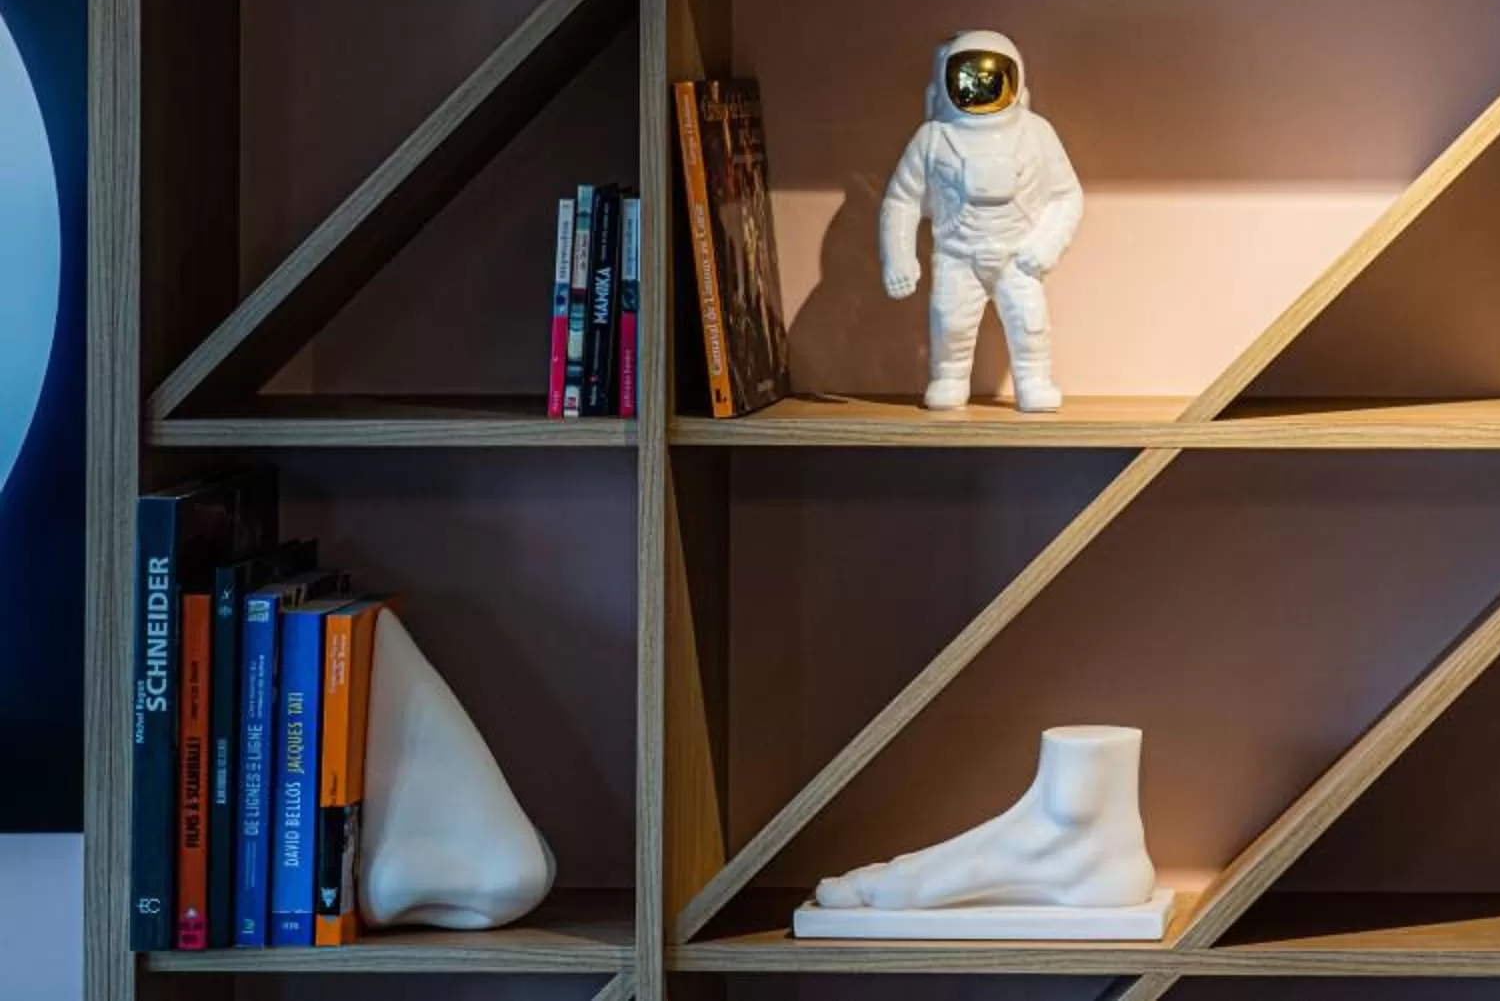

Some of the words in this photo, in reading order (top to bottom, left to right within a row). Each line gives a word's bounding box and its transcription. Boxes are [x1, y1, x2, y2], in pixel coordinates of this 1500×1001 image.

[146, 556, 169, 711] SCHNEIDER
[288, 692, 304, 716] TATI
[287, 722, 305, 775] JACQUES
[285, 781, 301, 826] BELLOS
[284, 831, 300, 867] DAVID
